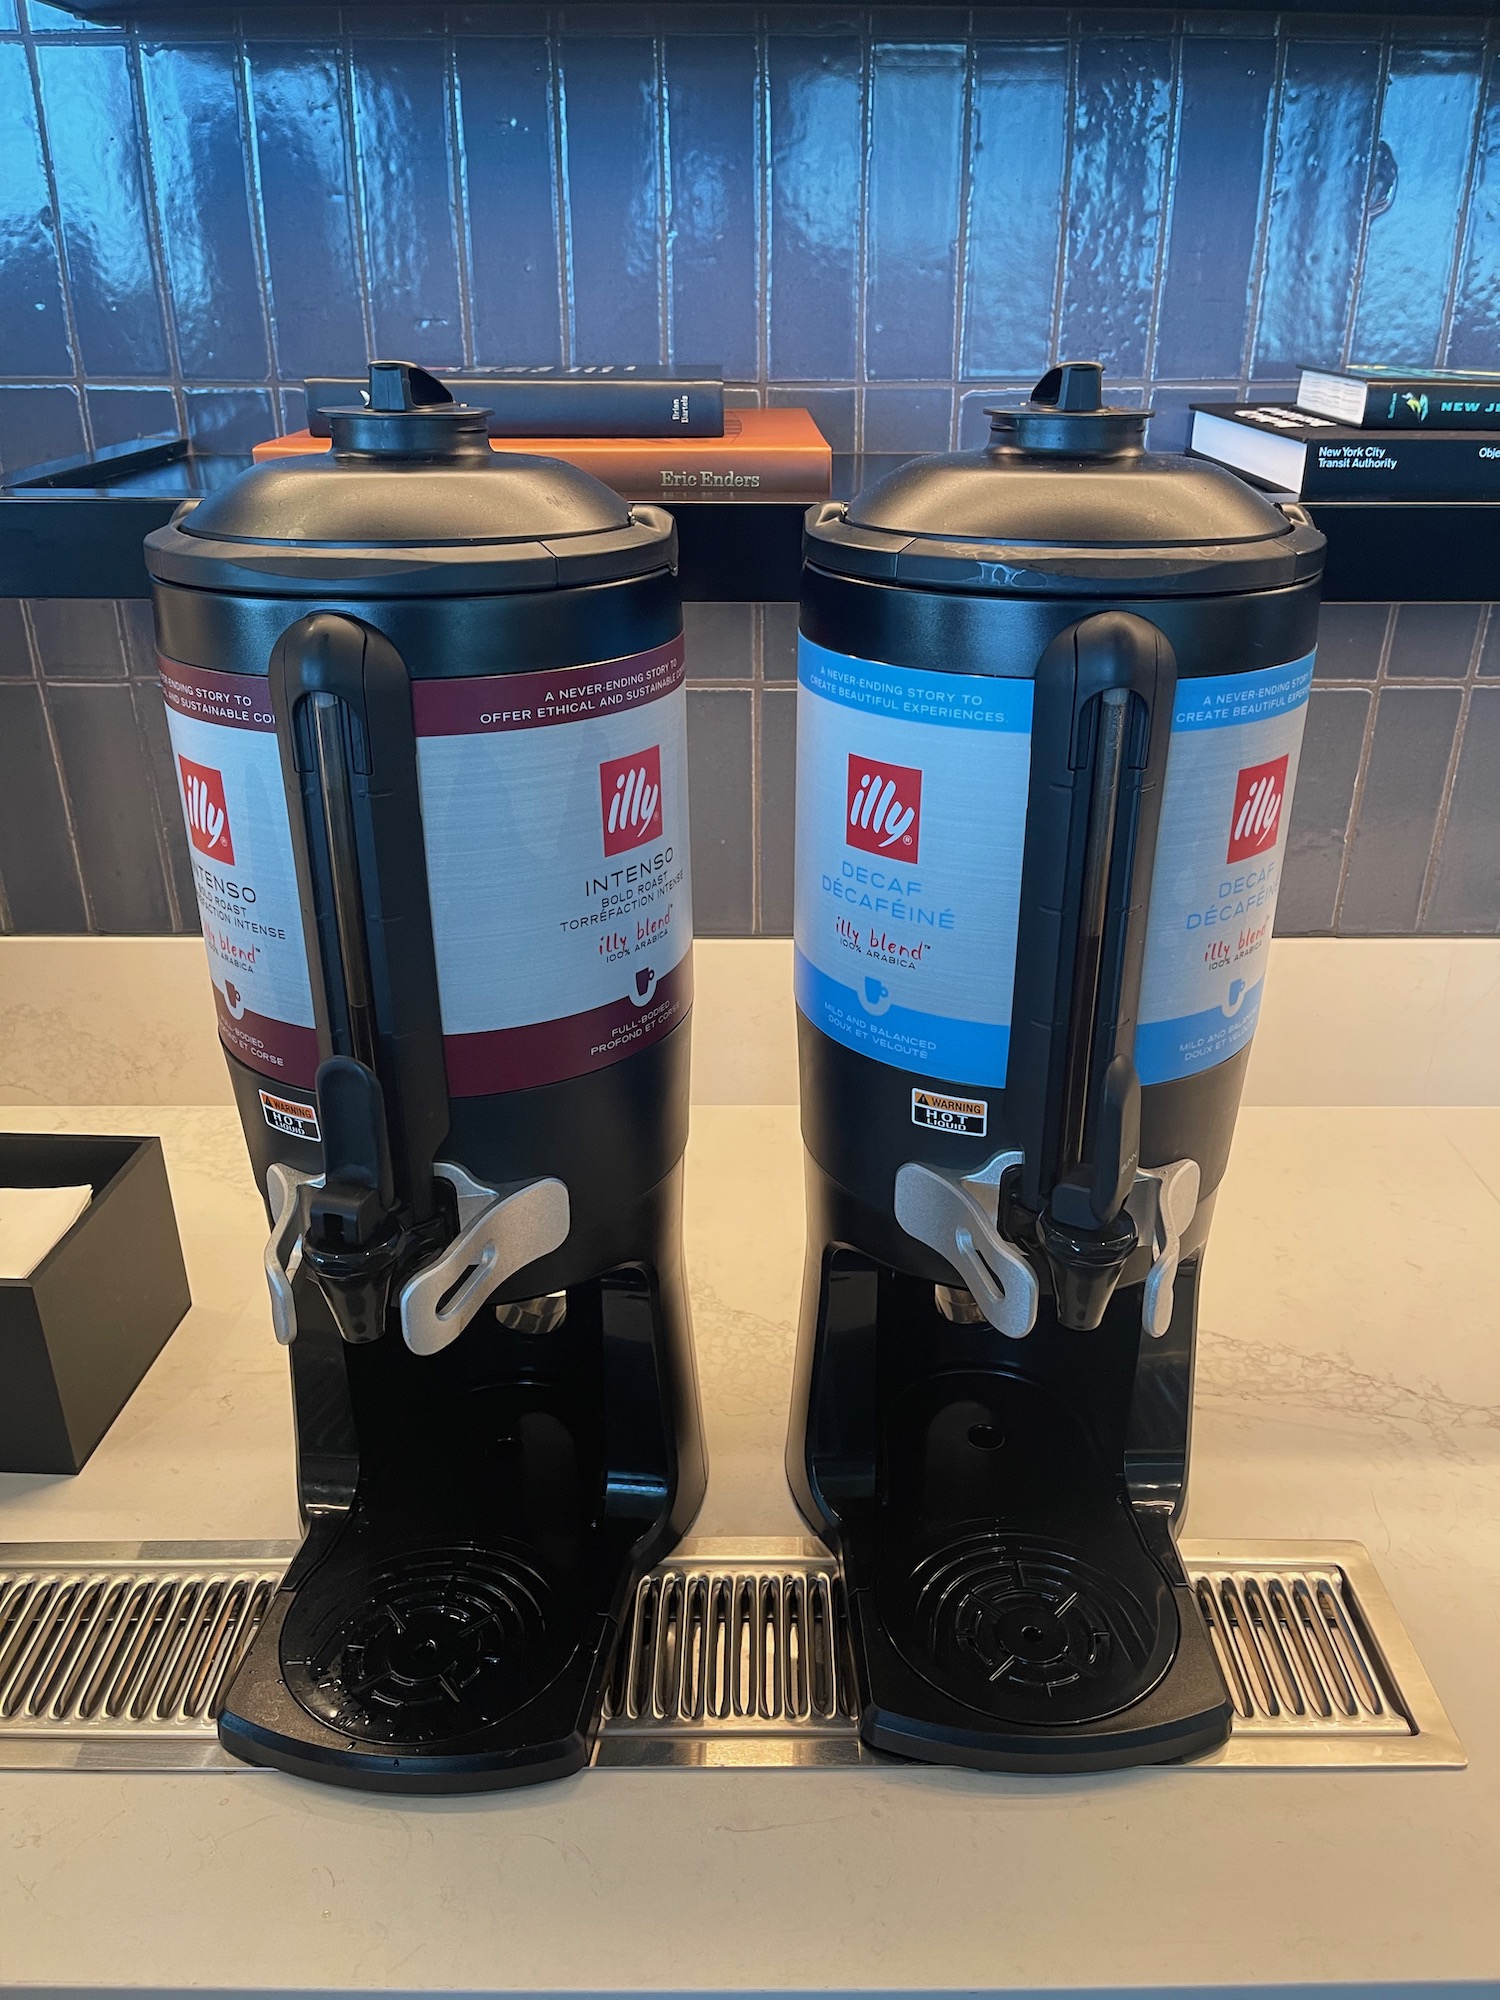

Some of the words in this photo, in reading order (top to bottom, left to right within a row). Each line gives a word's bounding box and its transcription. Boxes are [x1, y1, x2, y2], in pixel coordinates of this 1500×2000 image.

[1441, 402, 1480, 412] NEW
[1318, 458, 1350, 468] Transit
[1352, 458, 1398, 470] Authority
[1319, 446, 1341, 457] New
[1342, 446, 1363, 457] York
[1365, 446, 1386, 459] City
[661, 470, 698, 487] Eric
[700, 470, 760, 488] Enders
[544, 691, 555, 702] A
[559, 672, 644, 700] NEVER-ENDING
[646, 663, 670, 680] STORY
[810, 675, 836, 694] CREATE
[838, 687, 899, 710] BEAUTIFUL
[820, 666, 826, 676] A
[827, 669, 903, 696] NEVER-ENDING
[907, 688, 956, 703] STORY
[961, 694, 983, 706] TO
[1203, 697, 1211, 706] A
[1216, 681, 1290, 704] NEVER-ENDING
[180, 697, 249, 721] SUSTAINABLE
[195, 687, 230, 704] STORY
[234, 695, 252, 706] TO
[480, 709, 532, 724] OFFER
[537, 701, 595, 718] ETHICAL
[600, 693, 623, 707] AND
[626, 672, 676, 700] SUSTAINABLE
[1176, 707, 1229, 723] CREATE
[1233, 697, 1286, 717] BEAUTIFUL
[187, 774, 224, 848] illy
[607, 767, 659, 838] illy
[850, 774, 915, 847] illy
[1234, 776, 1281, 846] illy
[585, 847, 674, 897] INTENSO
[842, 861, 922, 896] DECAF
[1218, 862, 1275, 898] DECAF
[560, 895, 654, 932] TORRÉFACTION
[657, 869, 683, 899] INTENSE
[601, 889, 634, 909] BOLD
[637, 871, 668, 893] ROAST
[822, 875, 955, 930] DÉCAFÉINÉ
[215, 896, 247, 917] ROAST
[234, 918, 286, 940] INTENSE
[836, 916, 859, 945] illy
[599, 933, 627, 955] illy
[606, 949, 631, 963] 100%
[634, 929, 669, 952] ARABICA
[840, 938, 862, 953] 100%
[866, 949, 916, 970] ARABICA
[1204, 941, 1230, 962] illy
[221, 953, 254, 973] ARABICA
[611, 1000, 671, 1037] FULL-BODIED
[824, 1001, 843, 1018] MILD
[846, 1015, 867, 1029] AND
[870, 1024, 937, 1050] BALANCED
[590, 1028, 643, 1055] PROFOND
[645, 1022, 657, 1032] ET
[828, 1014, 852, 1033] DOUX
[855, 1029, 868, 1040] ET
[872, 1035, 929, 1059] VELOUTÉ
[1179, 1038, 1204, 1052] MILD
[1207, 1029, 1226, 1043] AND
[1184, 1046, 1213, 1061] DOUX
[1215, 1038, 1227, 1049] ET
[250, 1047, 284, 1067] CORSE
[274, 1100, 312, 1118] WARNING
[926, 1109, 968, 1125] HOT
[931, 1097, 981, 1114] WARNING
[272, 1111, 303, 1128] HOT
[927, 1117, 967, 1131] LIQUID
